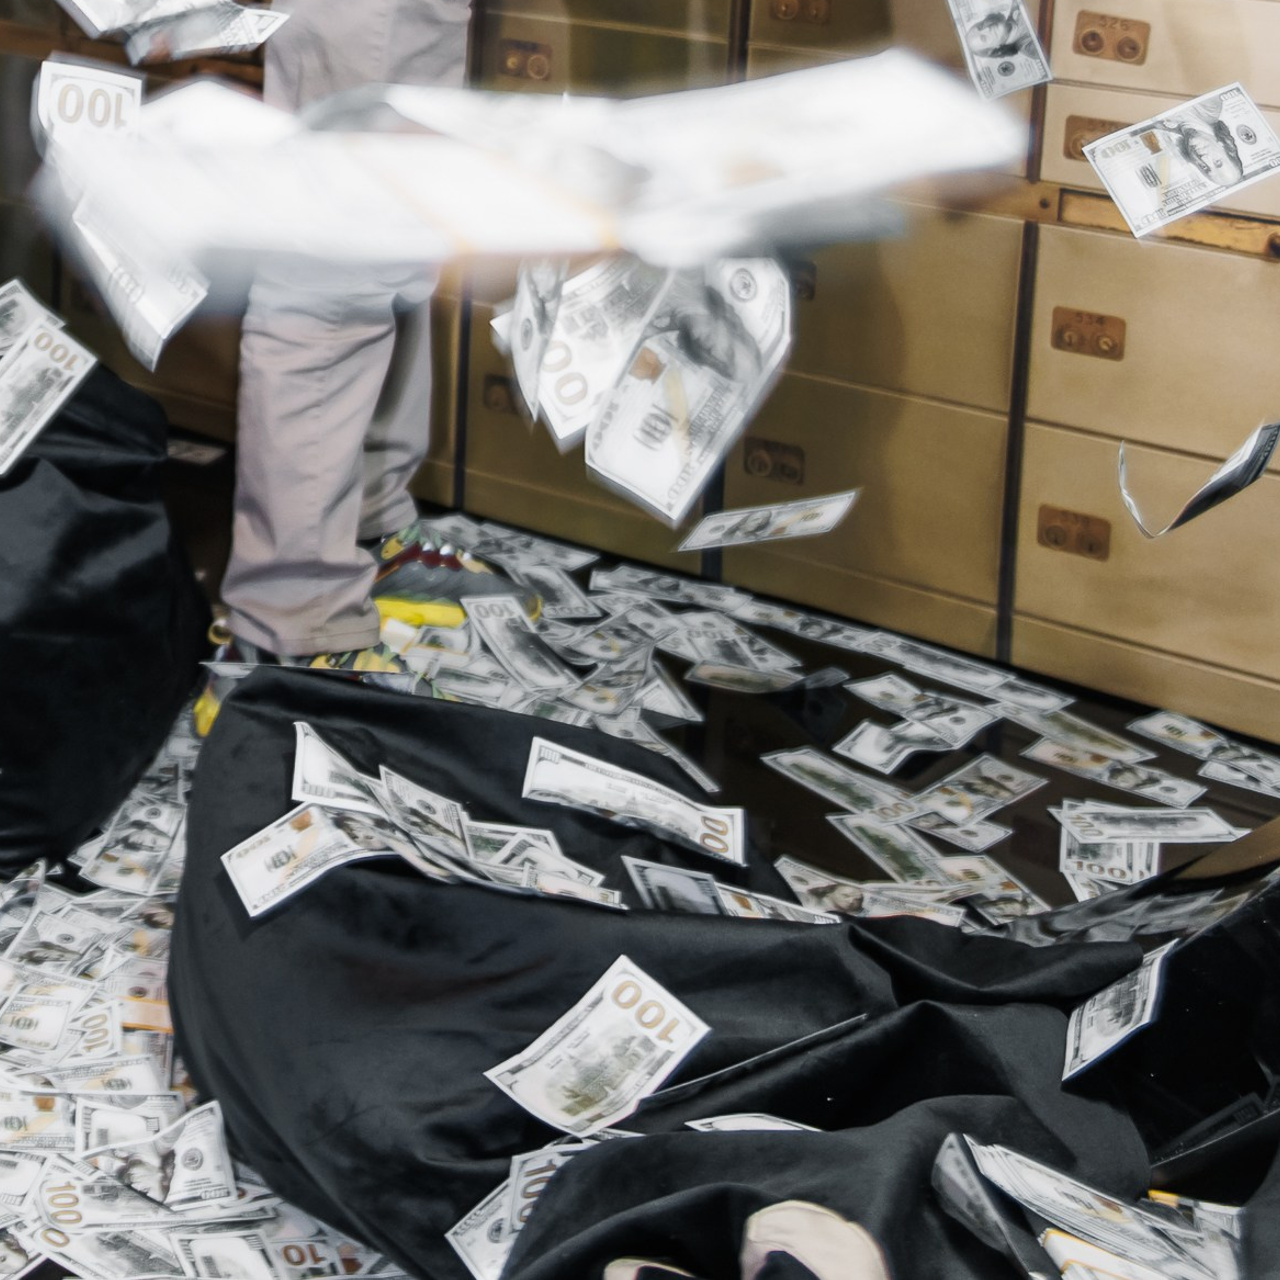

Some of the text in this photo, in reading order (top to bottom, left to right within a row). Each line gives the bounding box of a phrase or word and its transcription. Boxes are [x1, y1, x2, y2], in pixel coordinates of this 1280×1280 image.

[57, 83, 126, 129] 100
[34, 331, 81, 371] 100
[541, 339, 588, 406] 00
[474, 604, 514, 618] 100
[700, 815, 729, 853] 00
[81, 1013, 109, 1053] 100
[611, 980, 681, 1044] 100
[46, 1181, 83, 1225] 100
